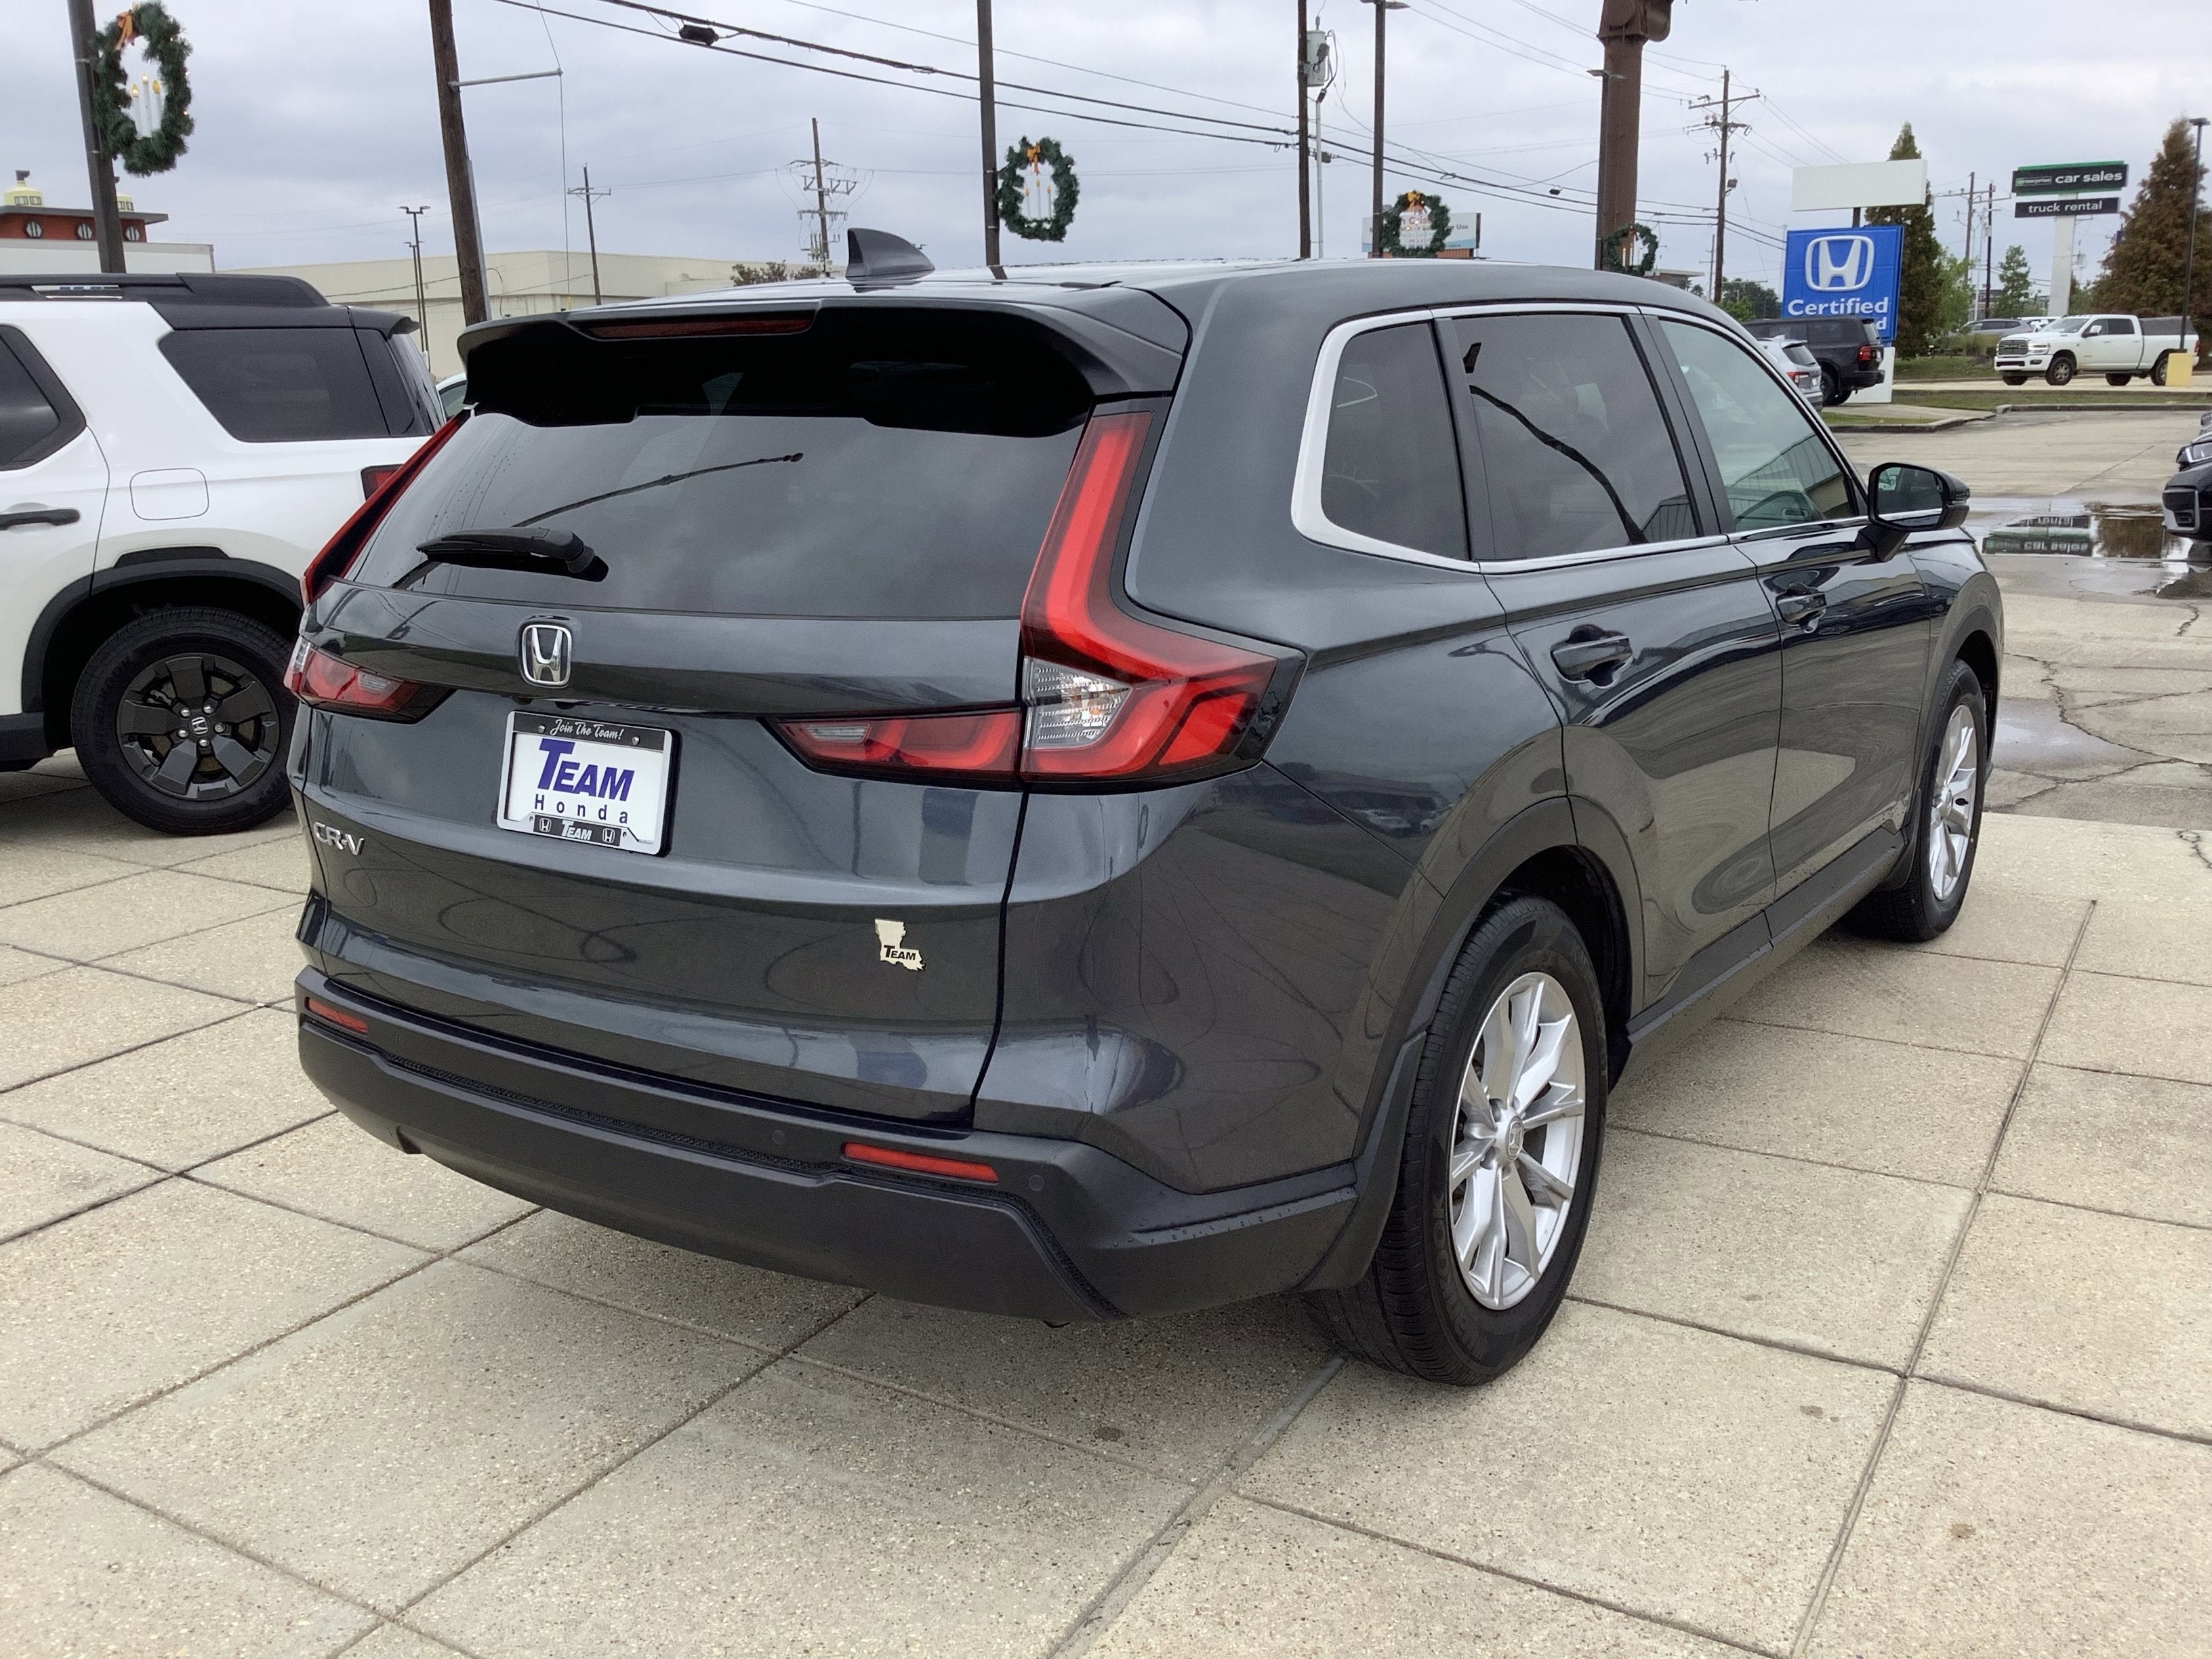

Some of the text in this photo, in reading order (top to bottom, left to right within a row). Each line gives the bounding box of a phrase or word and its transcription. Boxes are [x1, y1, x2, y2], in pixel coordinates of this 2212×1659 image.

[2055, 174, 2080, 184] car
[2083, 170, 2123, 182] sales
[2028, 200, 2102, 213] truck rental
[1788, 296, 1889, 316] Certified
[550, 719, 625, 740] Join The Team!
[537, 738, 635, 802] TEAM
[534, 794, 628, 824] Honda
[313, 821, 365, 855] CR-V
[561, 820, 592, 841] TEAM
[884, 945, 916, 960] TEAM
